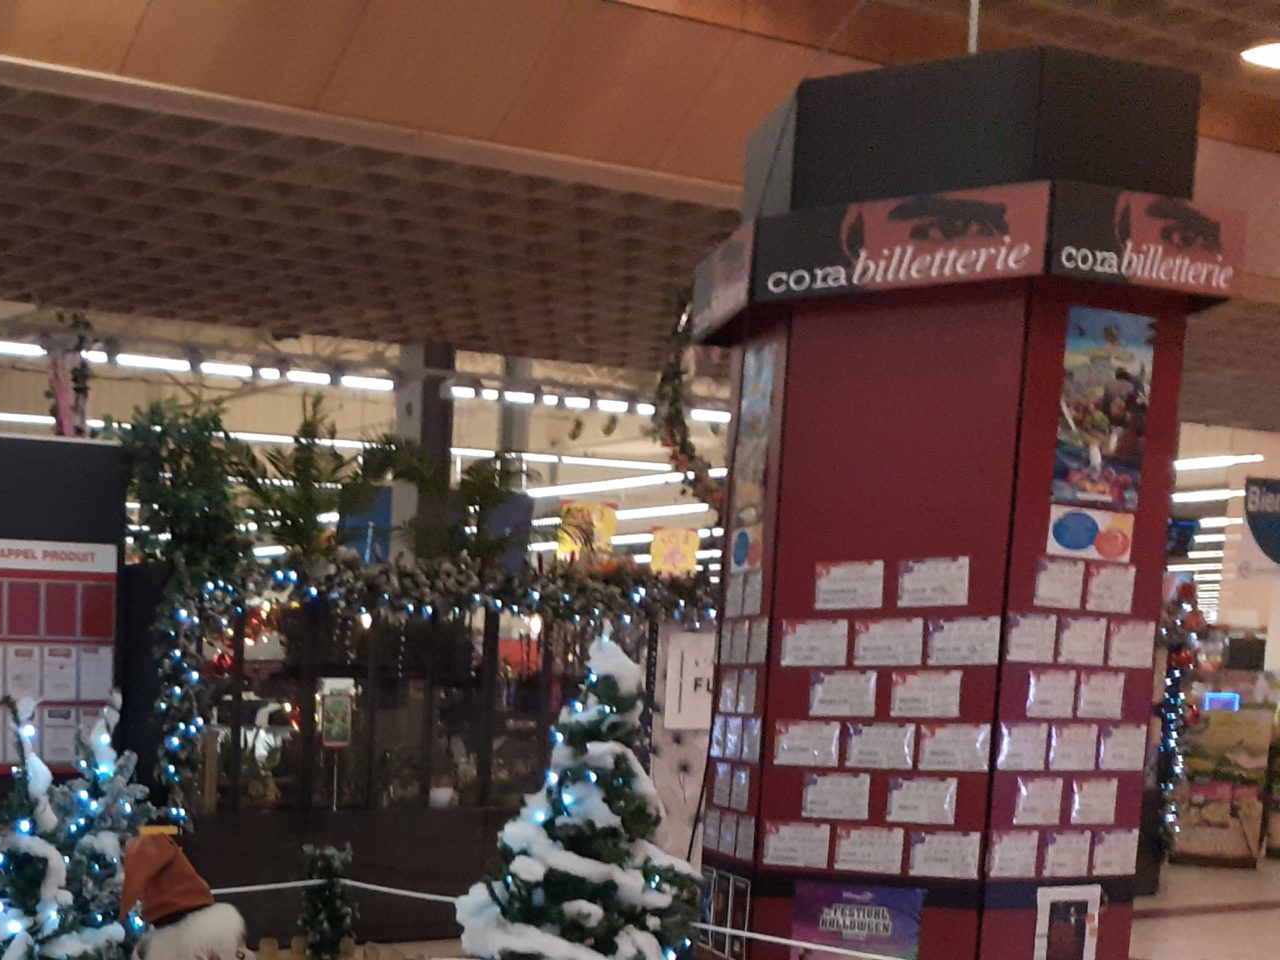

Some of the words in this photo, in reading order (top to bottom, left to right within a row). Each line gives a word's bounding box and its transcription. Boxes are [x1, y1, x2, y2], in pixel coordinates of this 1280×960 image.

[767, 265, 847, 294] cora
[851, 235, 1031, 285] billetterie
[1061, 245, 1118, 274] cora
[1121, 240, 1233, 289] billetterie
[43, 550, 96, 563] PRODUIT
